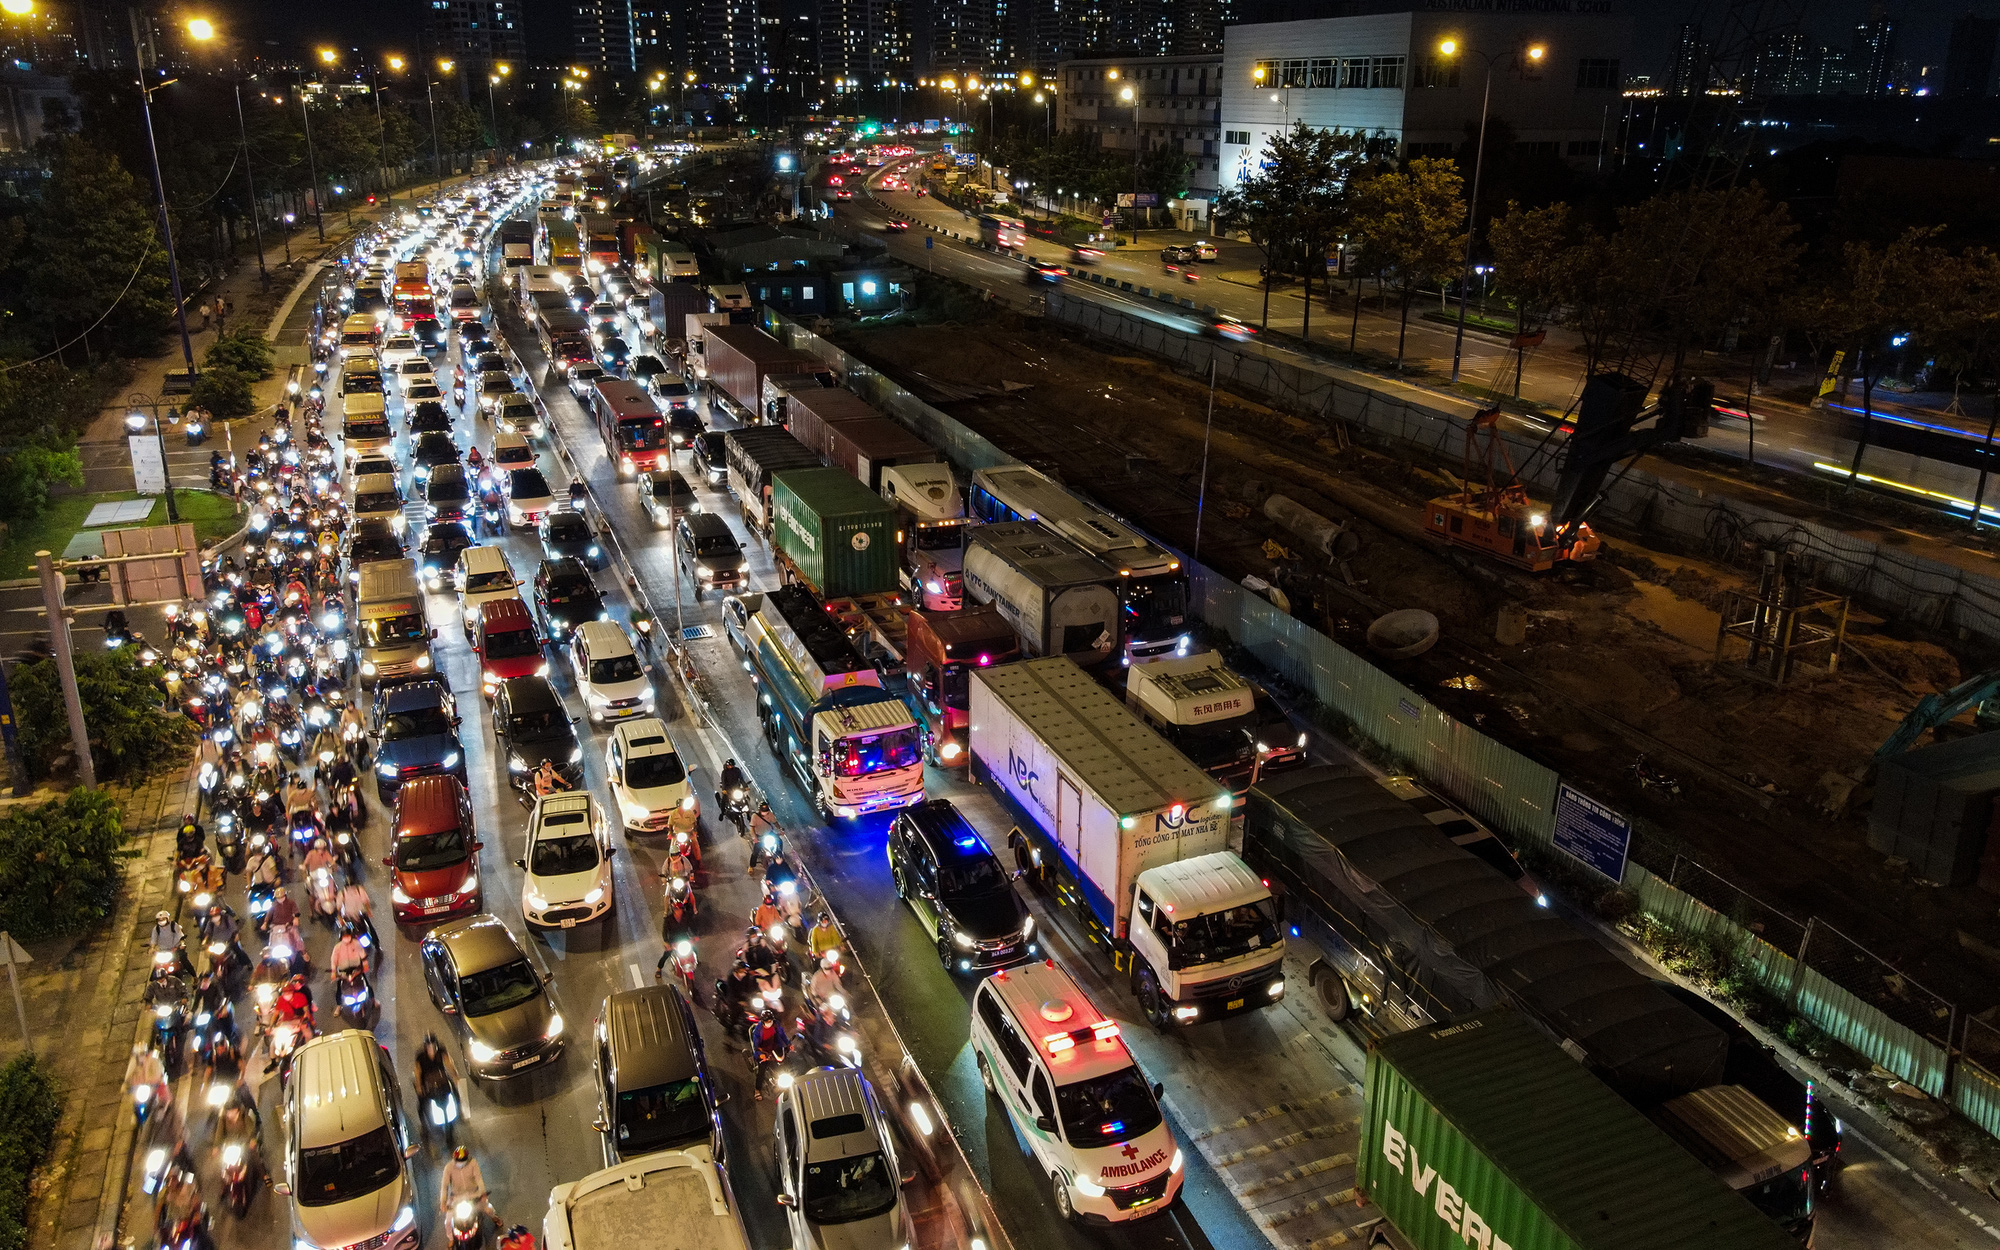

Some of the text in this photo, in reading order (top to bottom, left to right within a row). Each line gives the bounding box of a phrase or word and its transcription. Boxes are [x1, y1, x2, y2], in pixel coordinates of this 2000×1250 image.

[1496, 0, 1572, 12] INTERNATIONAL
[1576, 1, 1614, 13] SCHOOL
[970, 572, 1021, 618] VTG TANKTAINER
[1193, 699, 1242, 716] 东风商用车
[1172, 830, 1180, 840] TY
[1182, 827, 1194, 837] MAY
[1100, 1149, 1168, 1177] AMBULANCE
